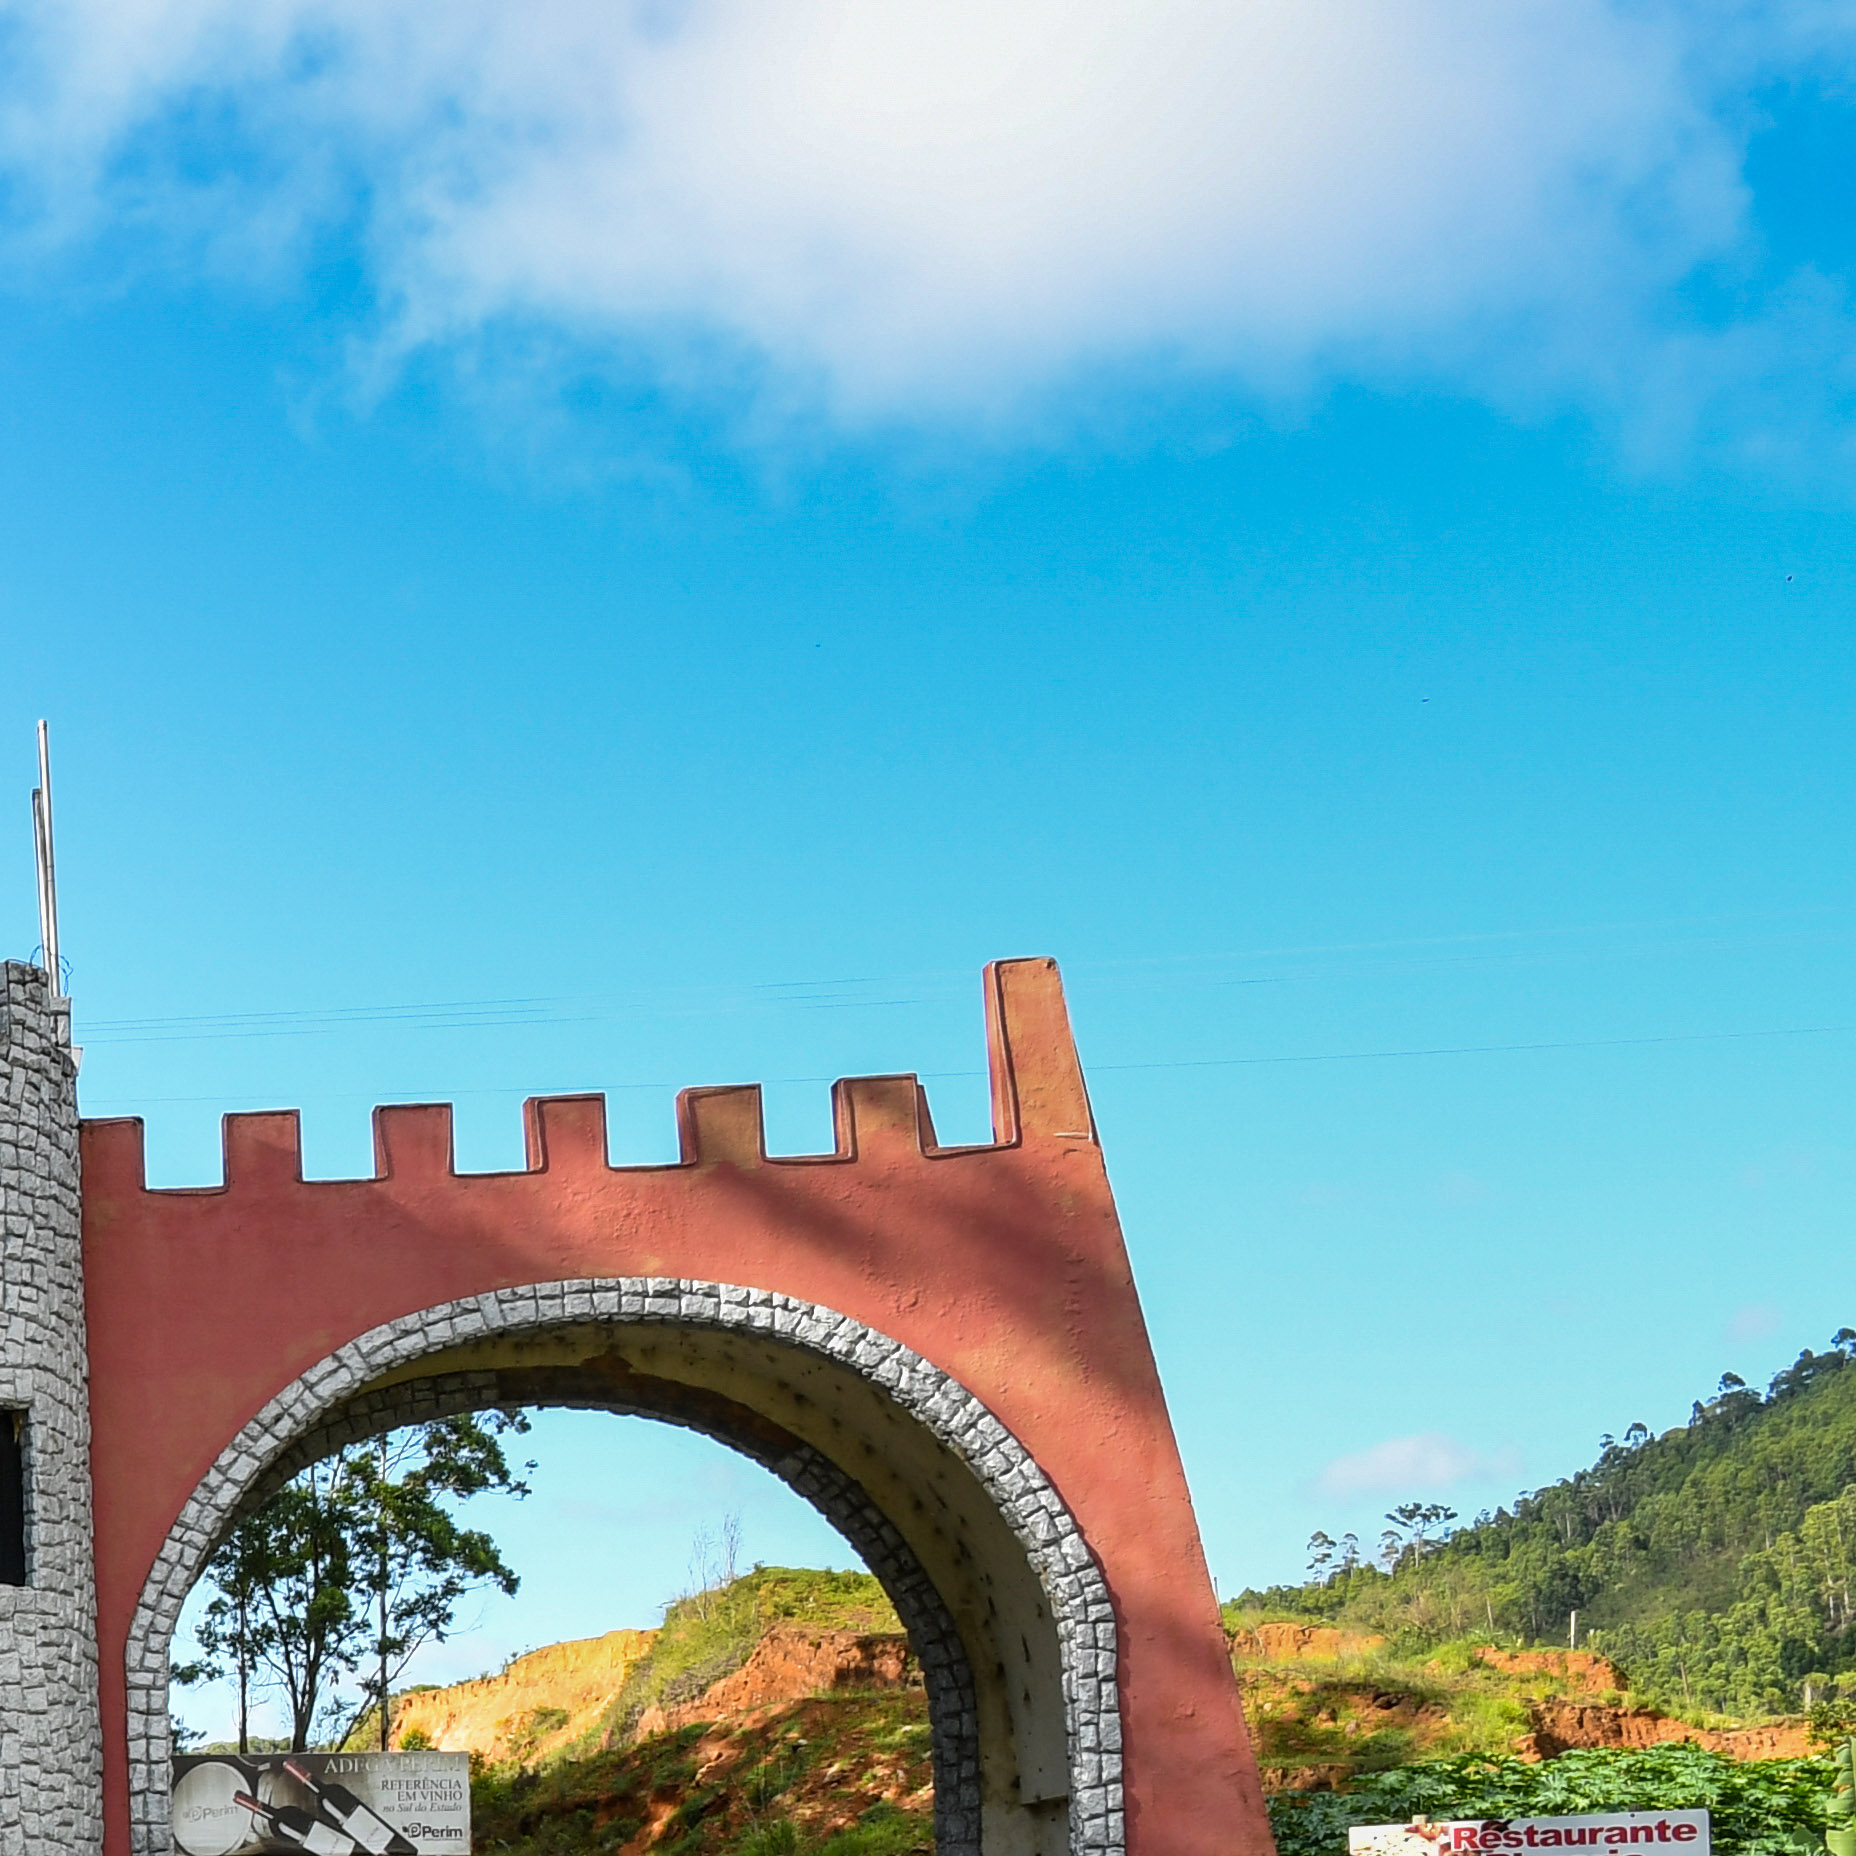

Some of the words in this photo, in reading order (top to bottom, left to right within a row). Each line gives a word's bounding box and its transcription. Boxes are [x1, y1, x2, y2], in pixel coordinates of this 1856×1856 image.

[381, 1776, 462, 1791] REFERÊNCIA
[397, 1790, 417, 1801] EM
[419, 1790, 463, 1801] VINHO
[429, 1802, 462, 1812] Estado
[422, 1825, 463, 1838] Perim
[1452, 1818, 1698, 1851] Restaurante
